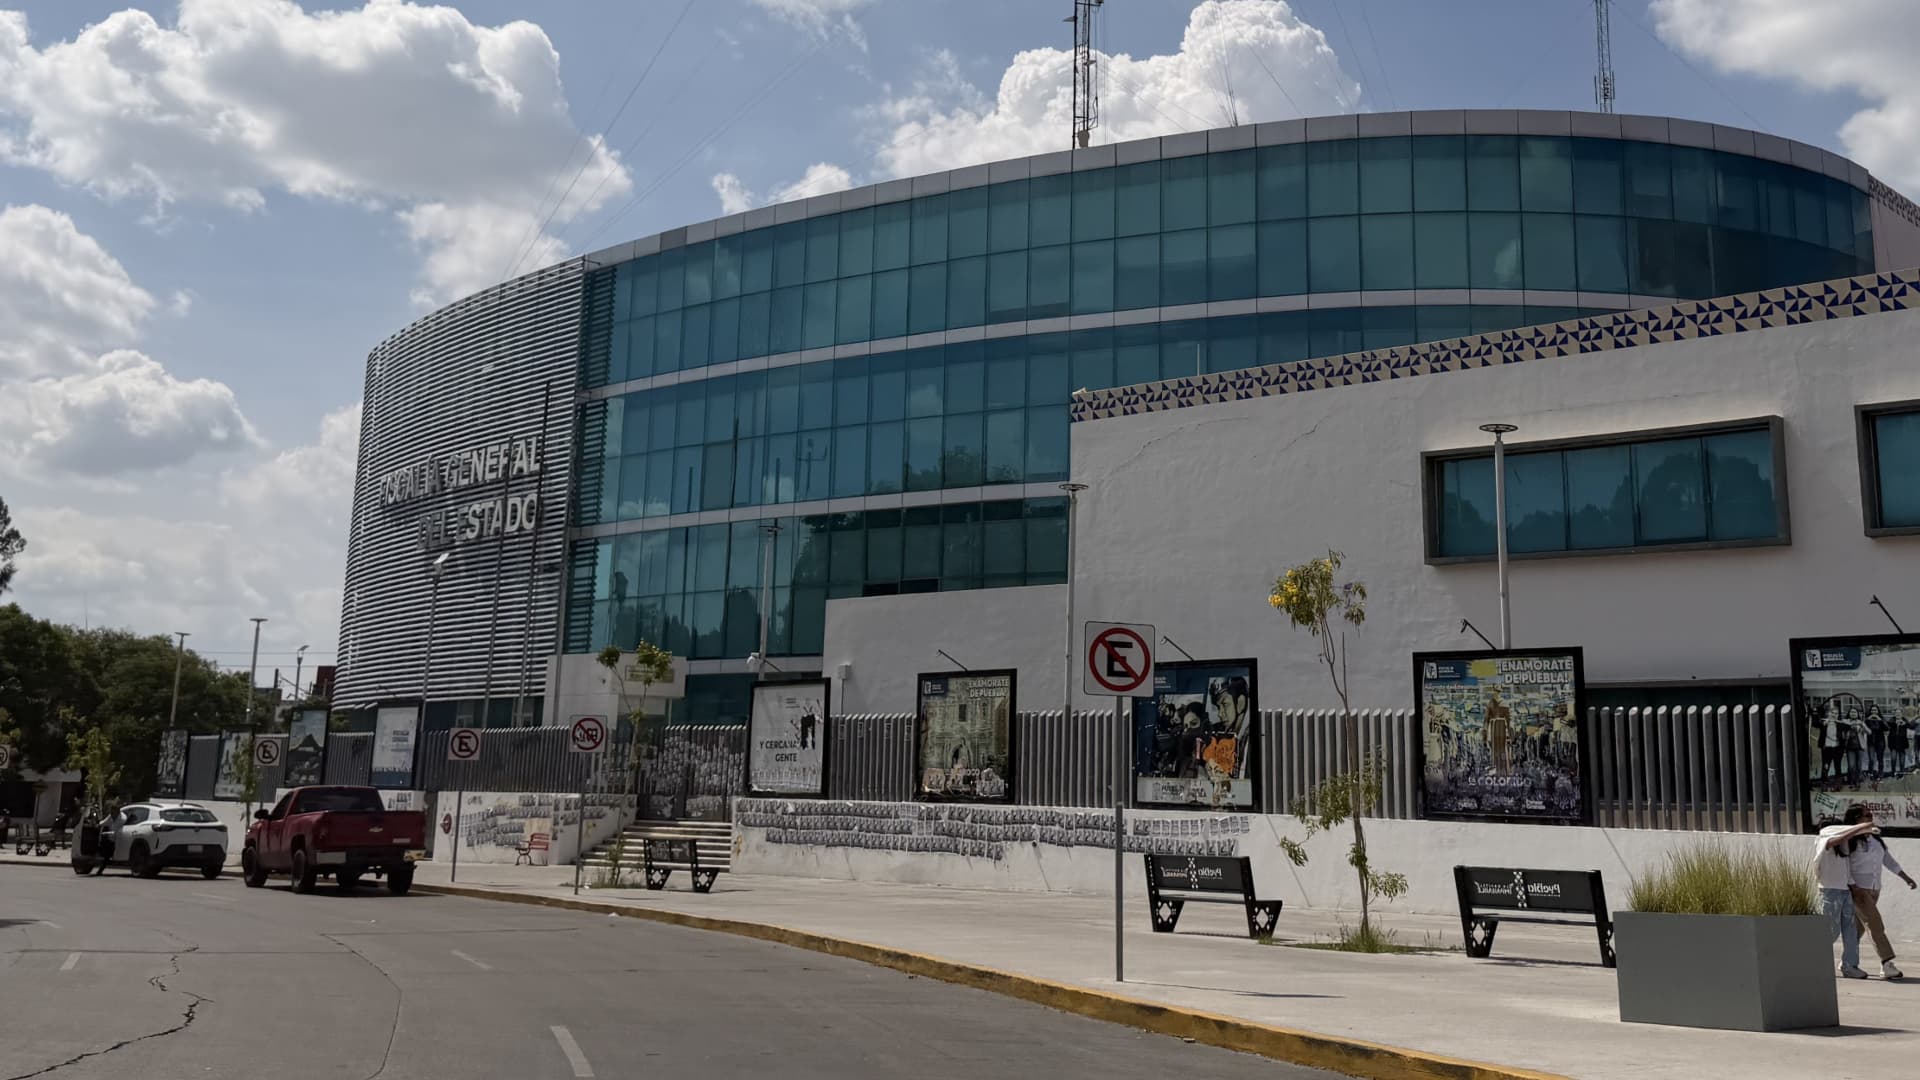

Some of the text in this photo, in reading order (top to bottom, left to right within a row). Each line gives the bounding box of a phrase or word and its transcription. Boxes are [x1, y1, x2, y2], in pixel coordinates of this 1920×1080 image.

[455, 494, 538, 544] ESTADO
[1505, 673, 1519, 684] DE
[776, 753, 797, 762] GENTE
